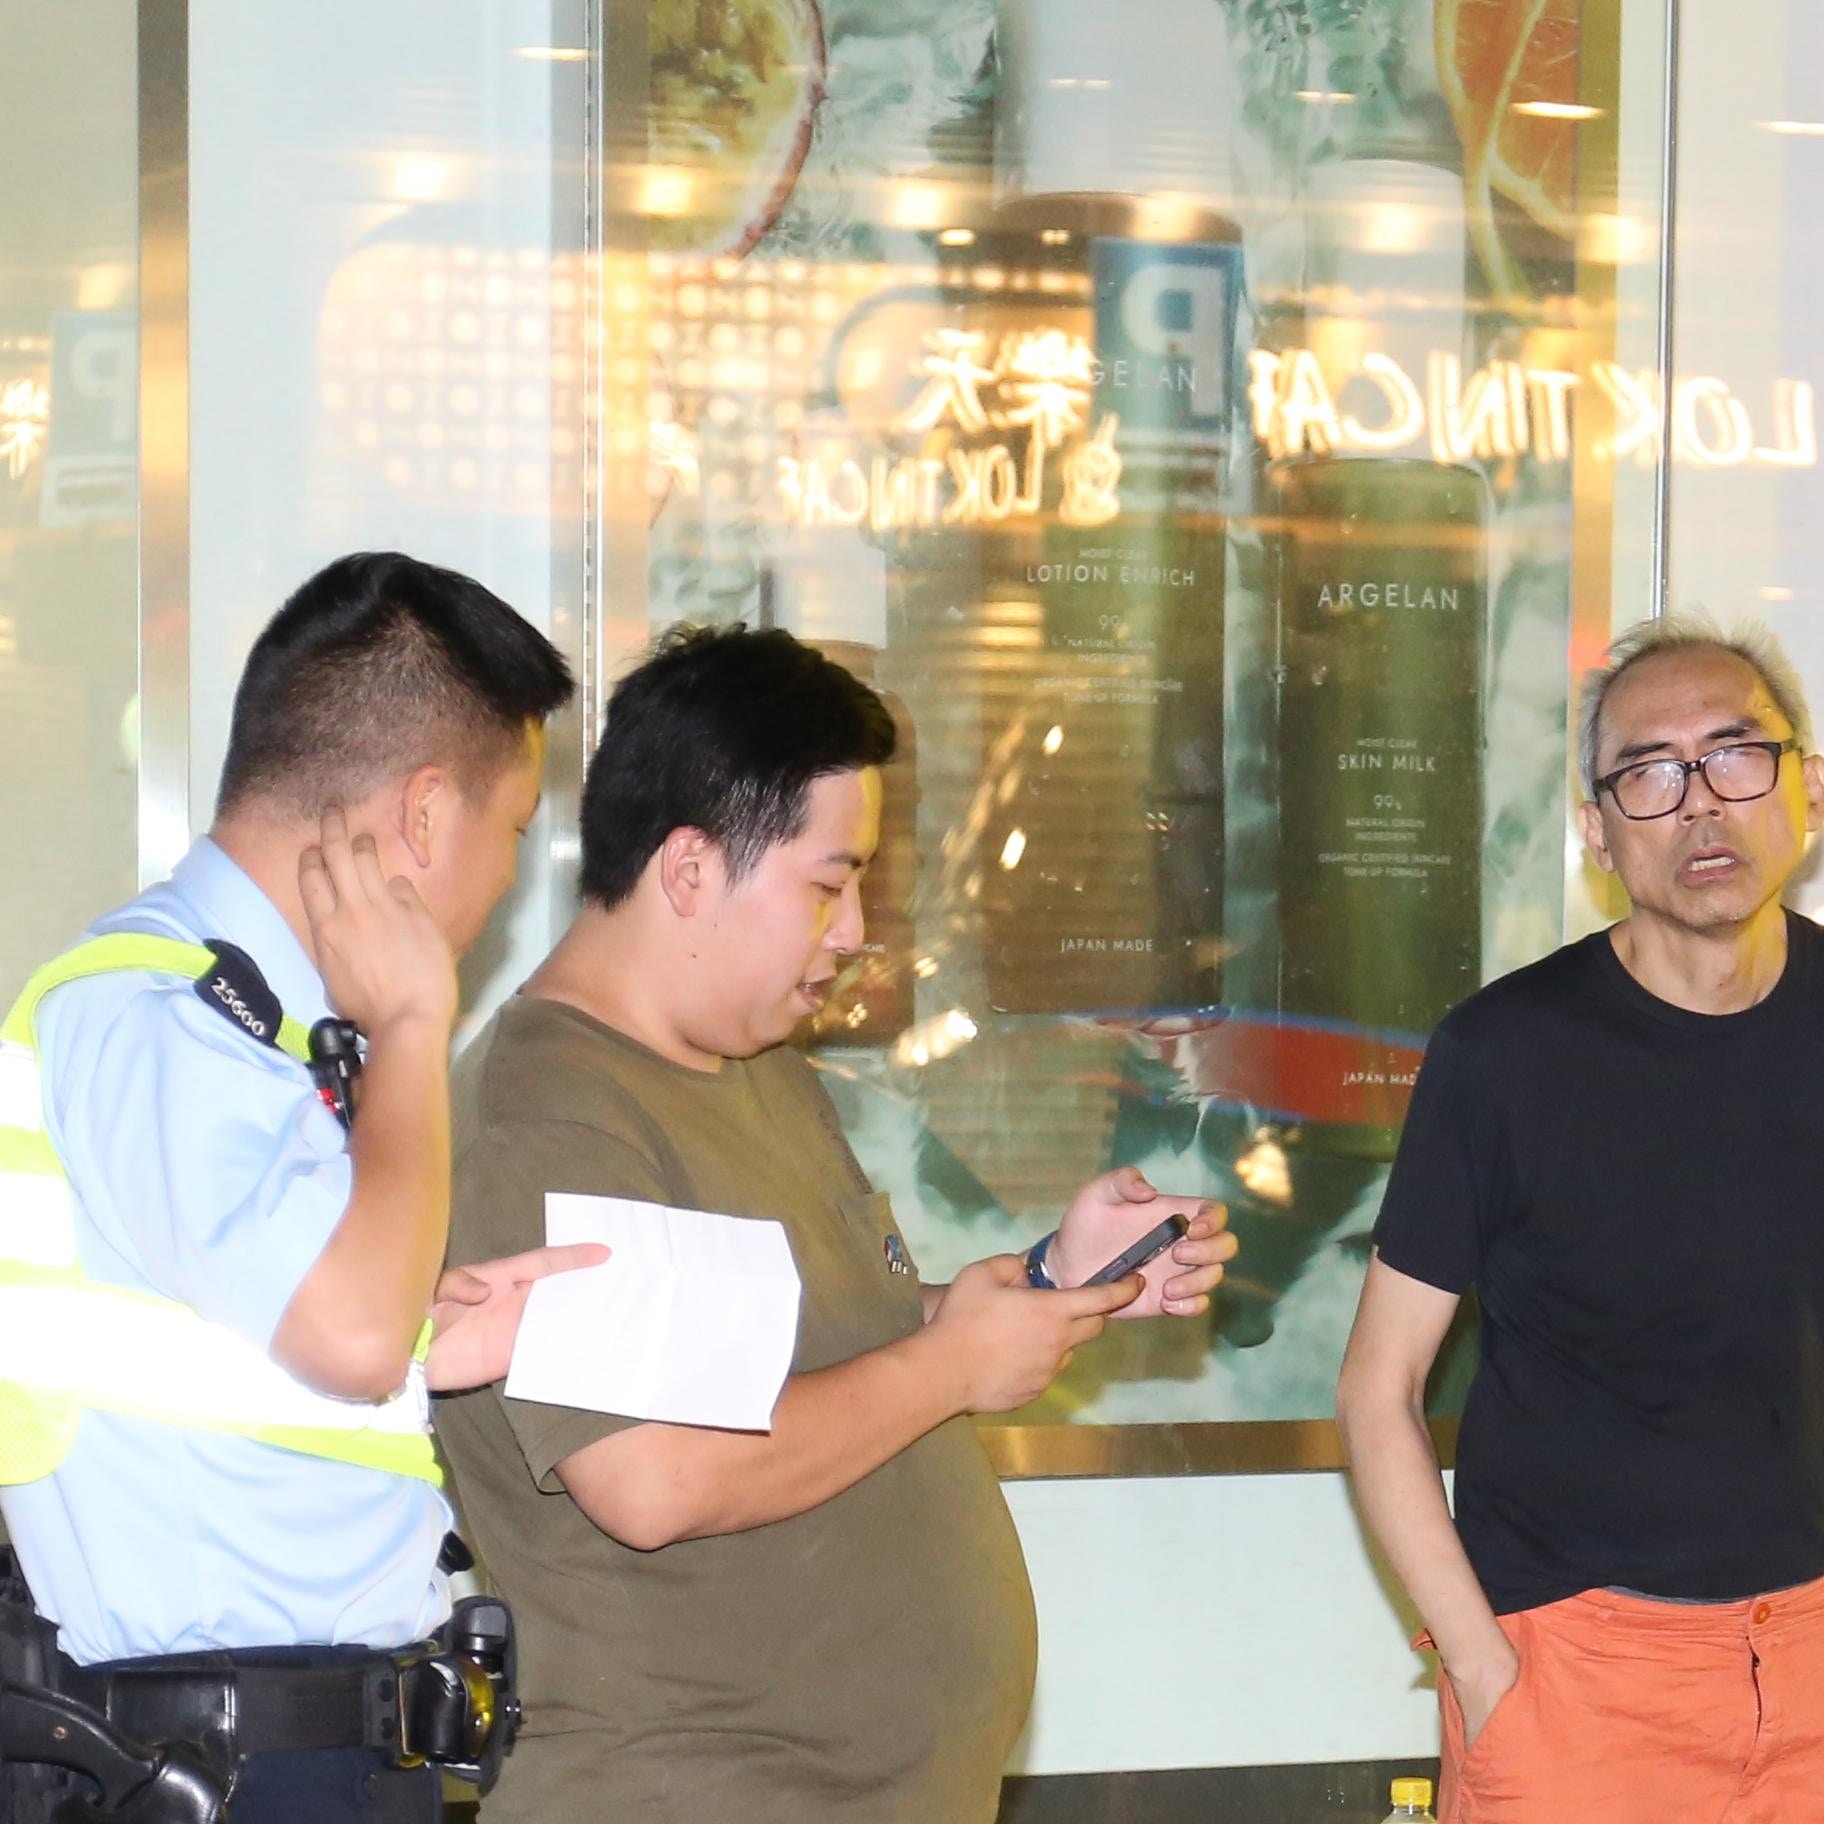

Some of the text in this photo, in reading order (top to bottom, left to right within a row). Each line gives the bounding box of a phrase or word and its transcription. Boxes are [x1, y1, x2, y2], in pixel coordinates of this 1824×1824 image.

[1027, 565, 1195, 586] LOTION ENRICH
[1317, 582, 1457, 610] ARGELAN
[1337, 754, 1436, 772] SKIN MILK
[1060, 938, 1154, 953] JAPAN MADE
[211, 976, 266, 1037] 25600
[1342, 1072, 1417, 1086] JAPAN MAD
